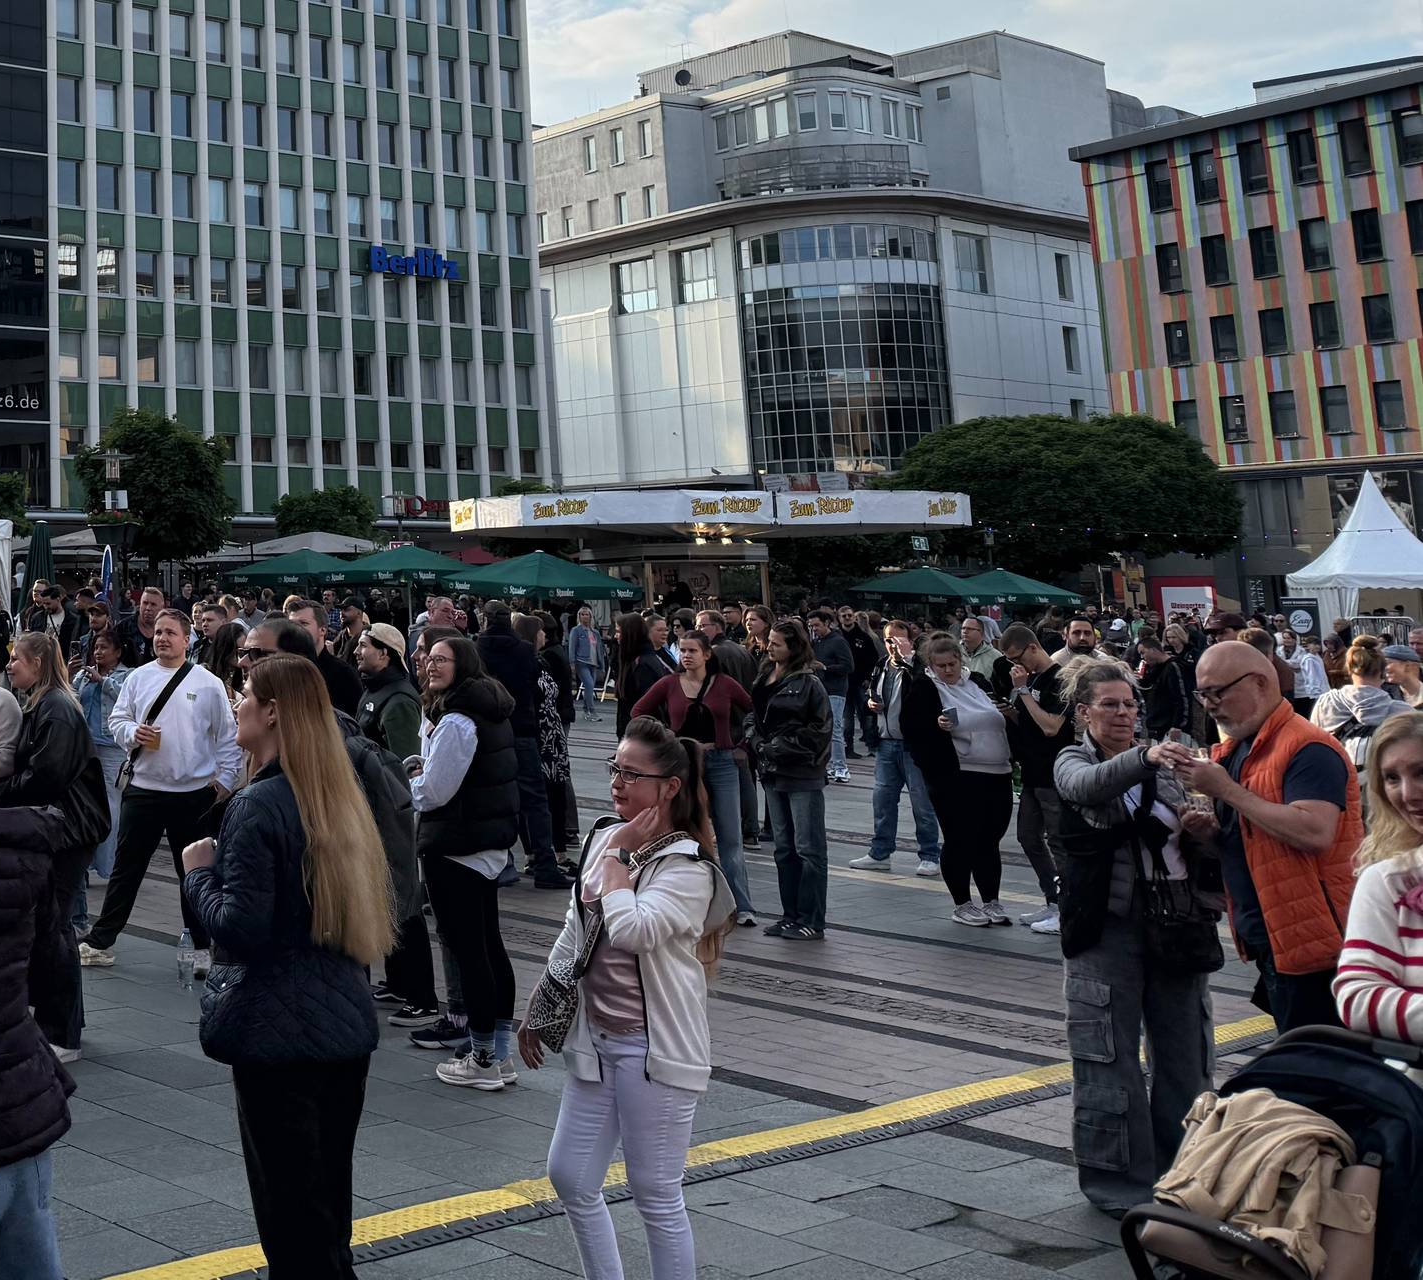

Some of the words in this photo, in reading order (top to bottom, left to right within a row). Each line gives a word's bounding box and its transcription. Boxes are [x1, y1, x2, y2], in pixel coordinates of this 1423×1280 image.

[370, 246, 461, 280] Berlitz
[533, 502, 556, 520] Zum
[691, 499, 721, 517] Zum
[722, 496, 762, 514] Ritter
[789, 500, 817, 518] Zum
[818, 497, 854, 515] Ritter
